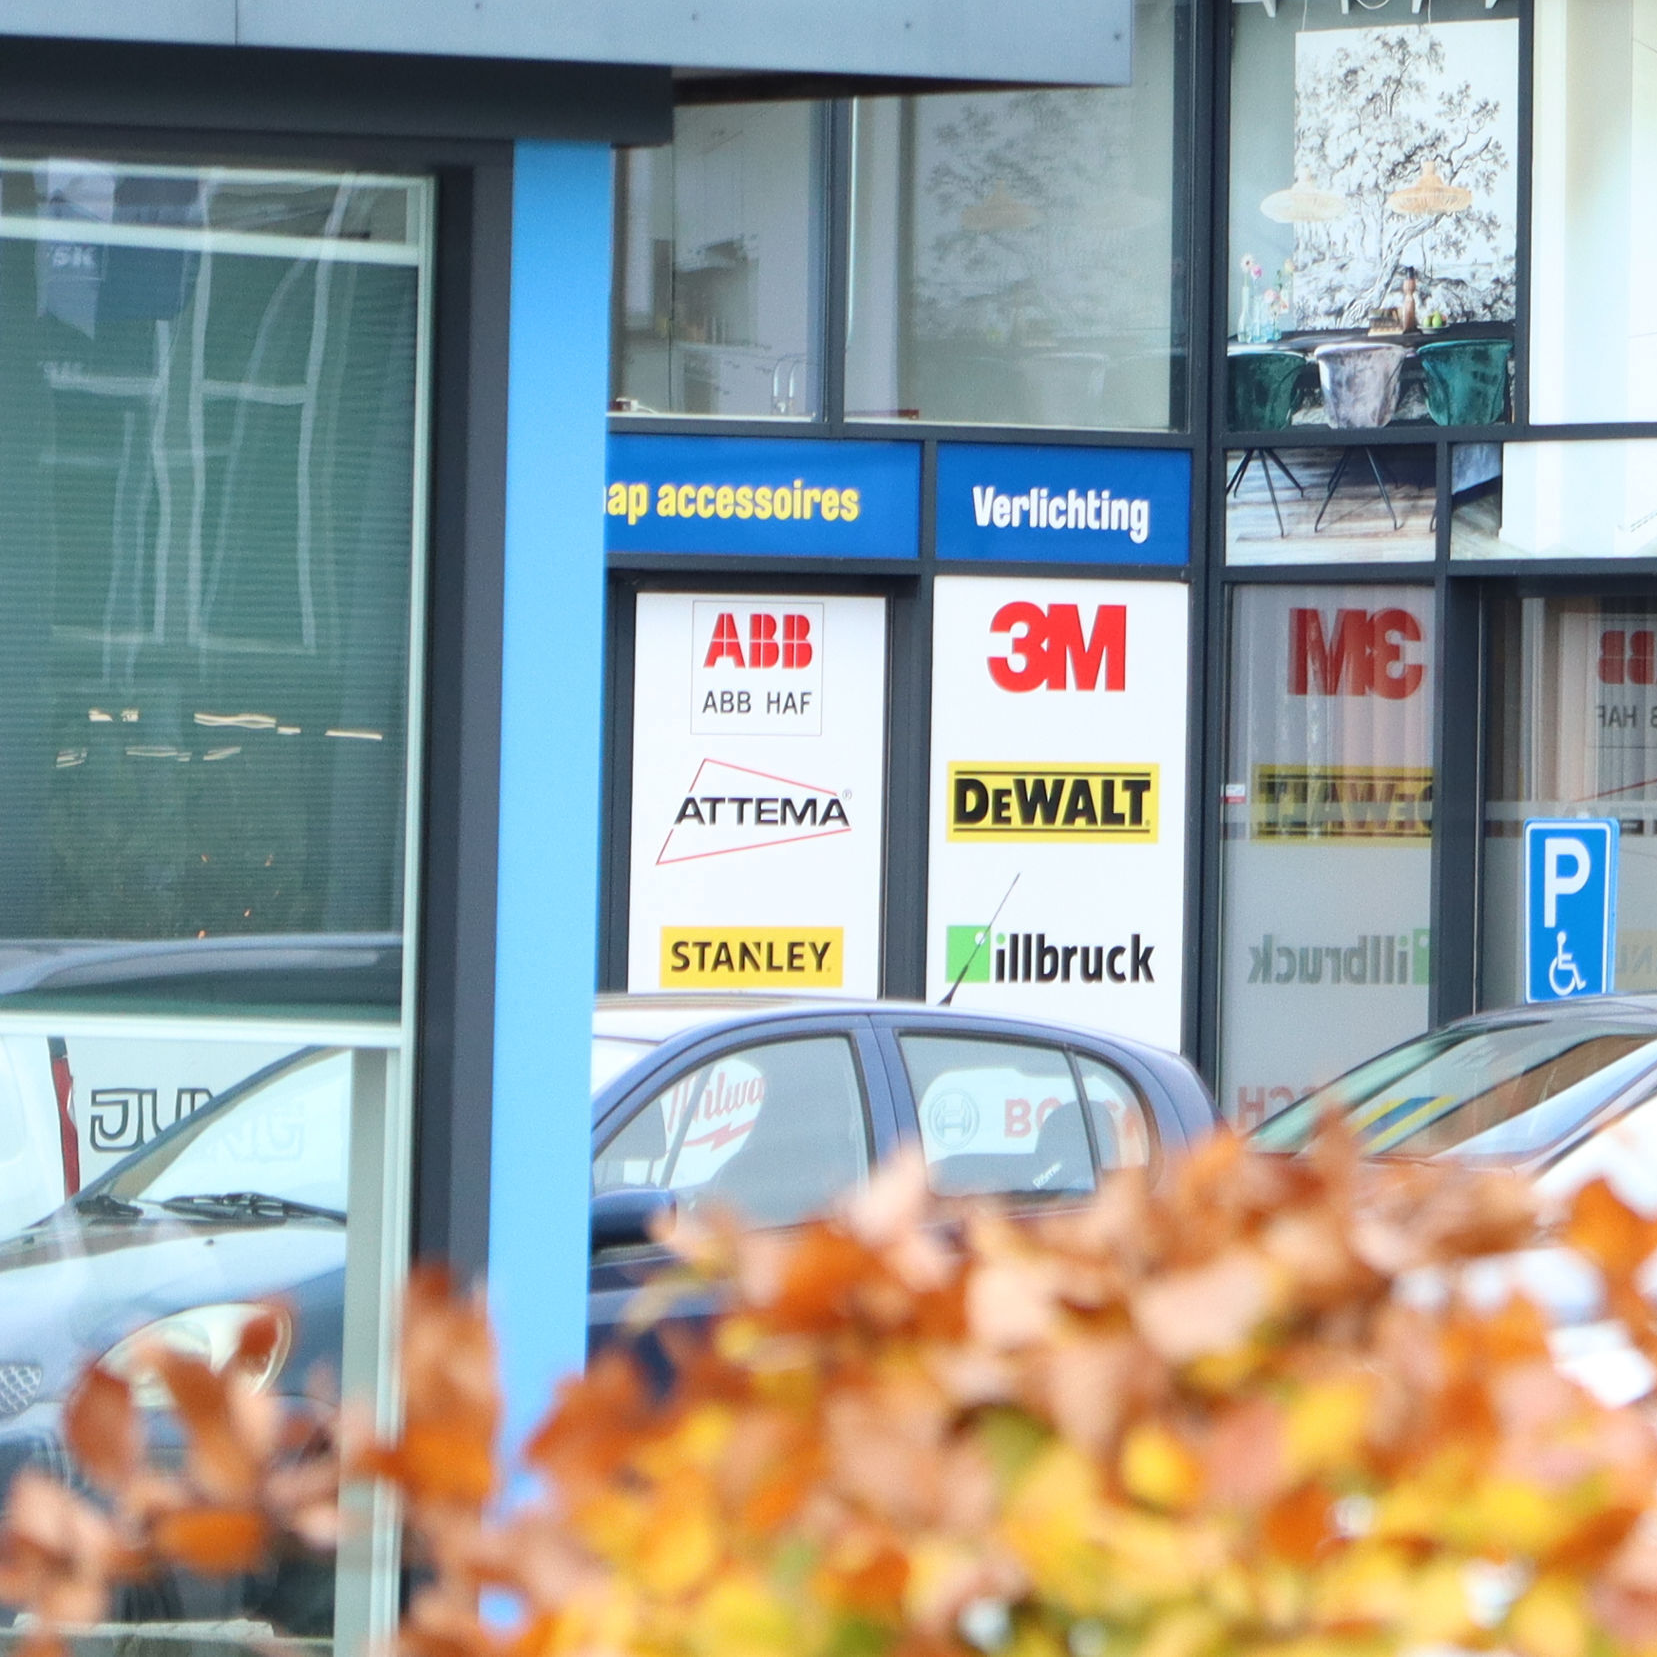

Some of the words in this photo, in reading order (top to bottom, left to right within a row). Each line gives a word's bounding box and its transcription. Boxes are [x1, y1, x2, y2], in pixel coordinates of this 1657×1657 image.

[603, 483, 648, 526] ap
[656, 479, 860, 522] accessoires
[973, 485, 1150, 544] Verlichting
[704, 612, 813, 669] ABB
[987, 600, 1128, 694] 3M
[702, 690, 752, 715] ABB
[766, 691, 812, 716] HAF
[674, 796, 851, 827] ATTEMA
[1544, 838, 1591, 928] P
[670, 939, 831, 973] STANLEY
[995, 933, 1155, 983] illbruck
